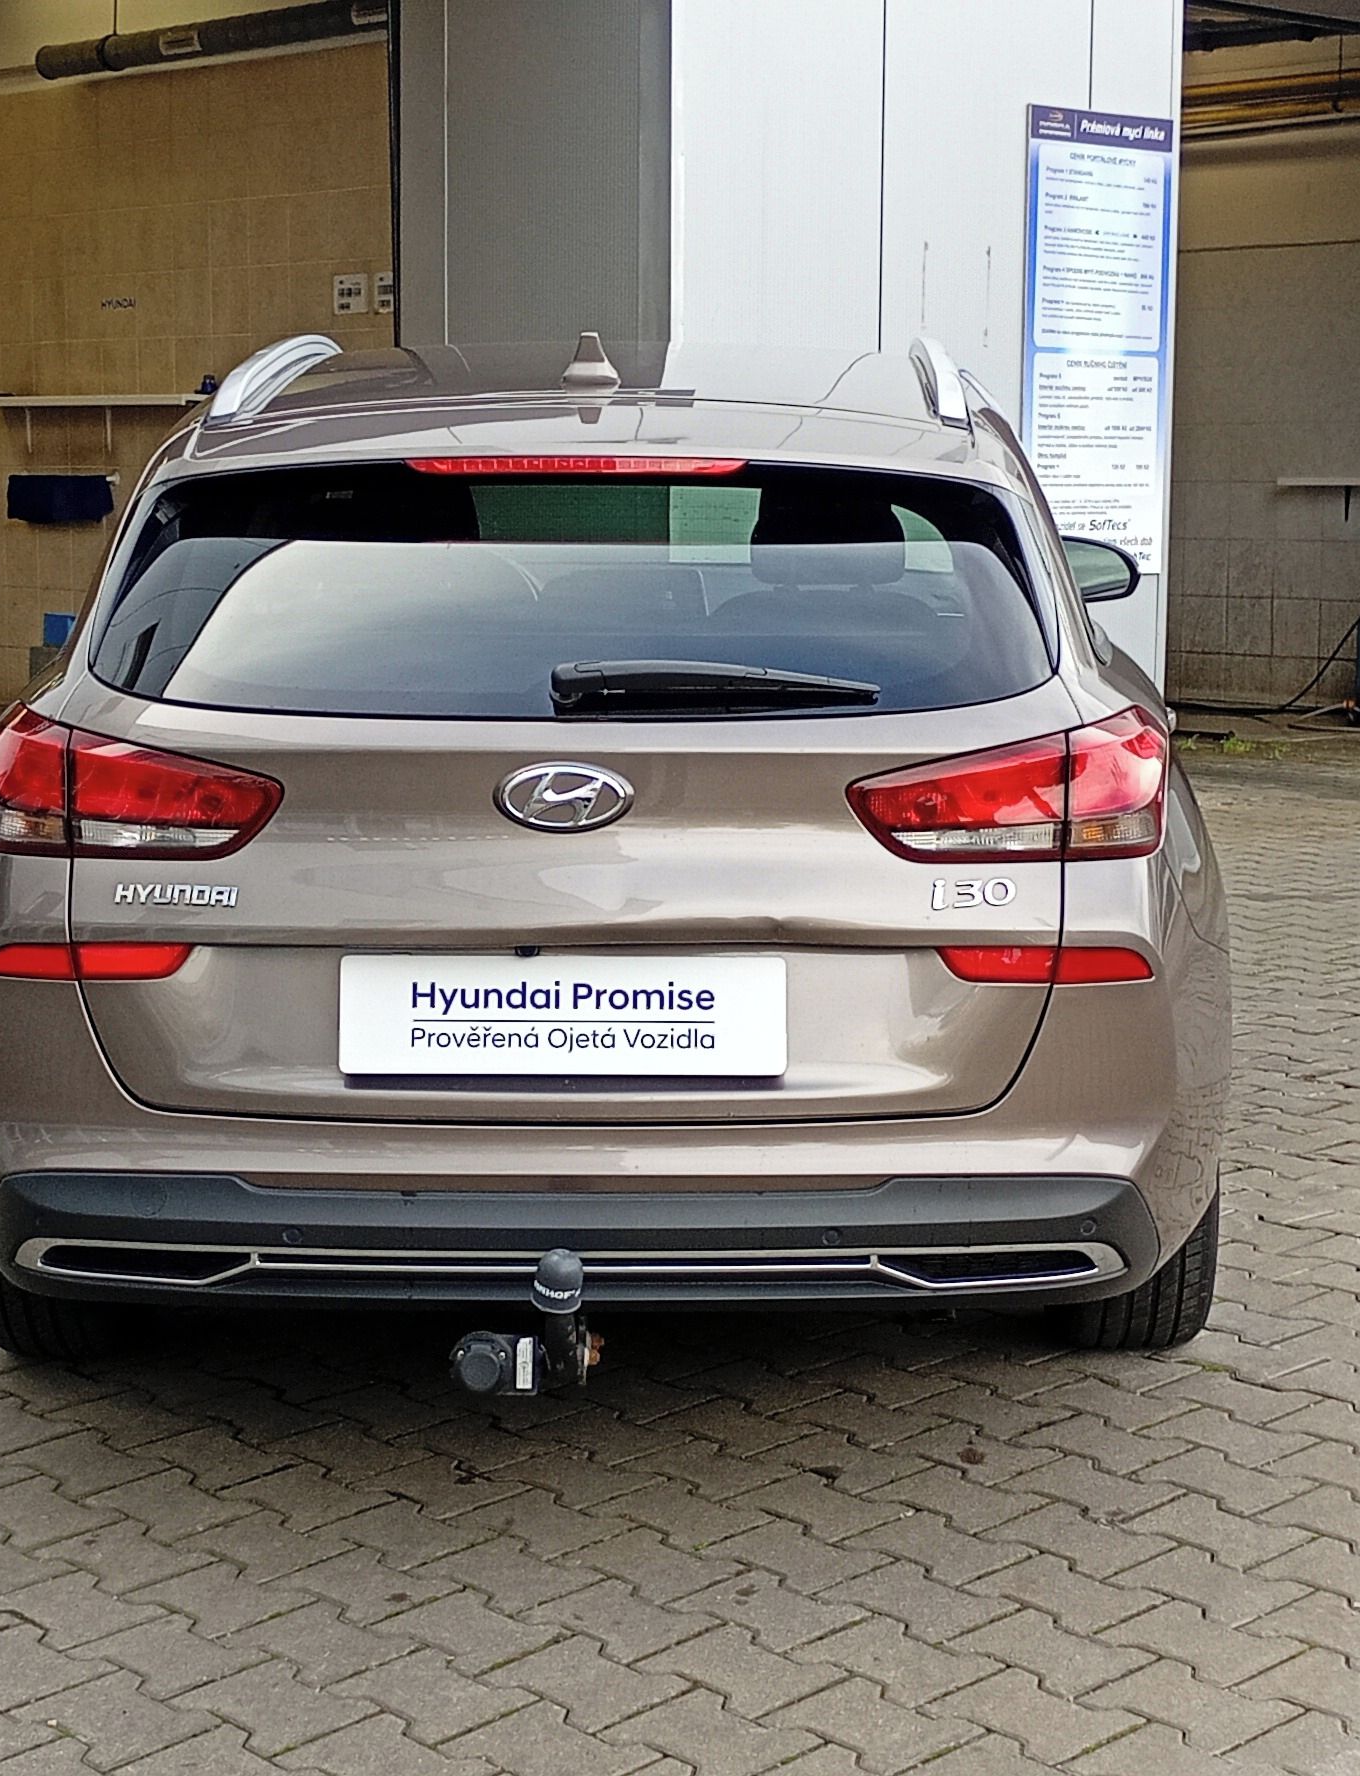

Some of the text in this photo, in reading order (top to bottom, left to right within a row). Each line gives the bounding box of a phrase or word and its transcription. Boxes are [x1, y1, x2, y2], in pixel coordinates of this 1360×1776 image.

[1143, 127, 1165, 142] linka
[100, 298, 136, 310] HYUNDAI
[1089, 519, 1128, 531] SofTecs
[114, 883, 238, 907] HYUNDAI
[931, 878, 1017, 911] i30
[411, 980, 715, 1015] Hyundai Promise
[411, 1026, 715, 1053] Prověřená Ojetá Vozidla
